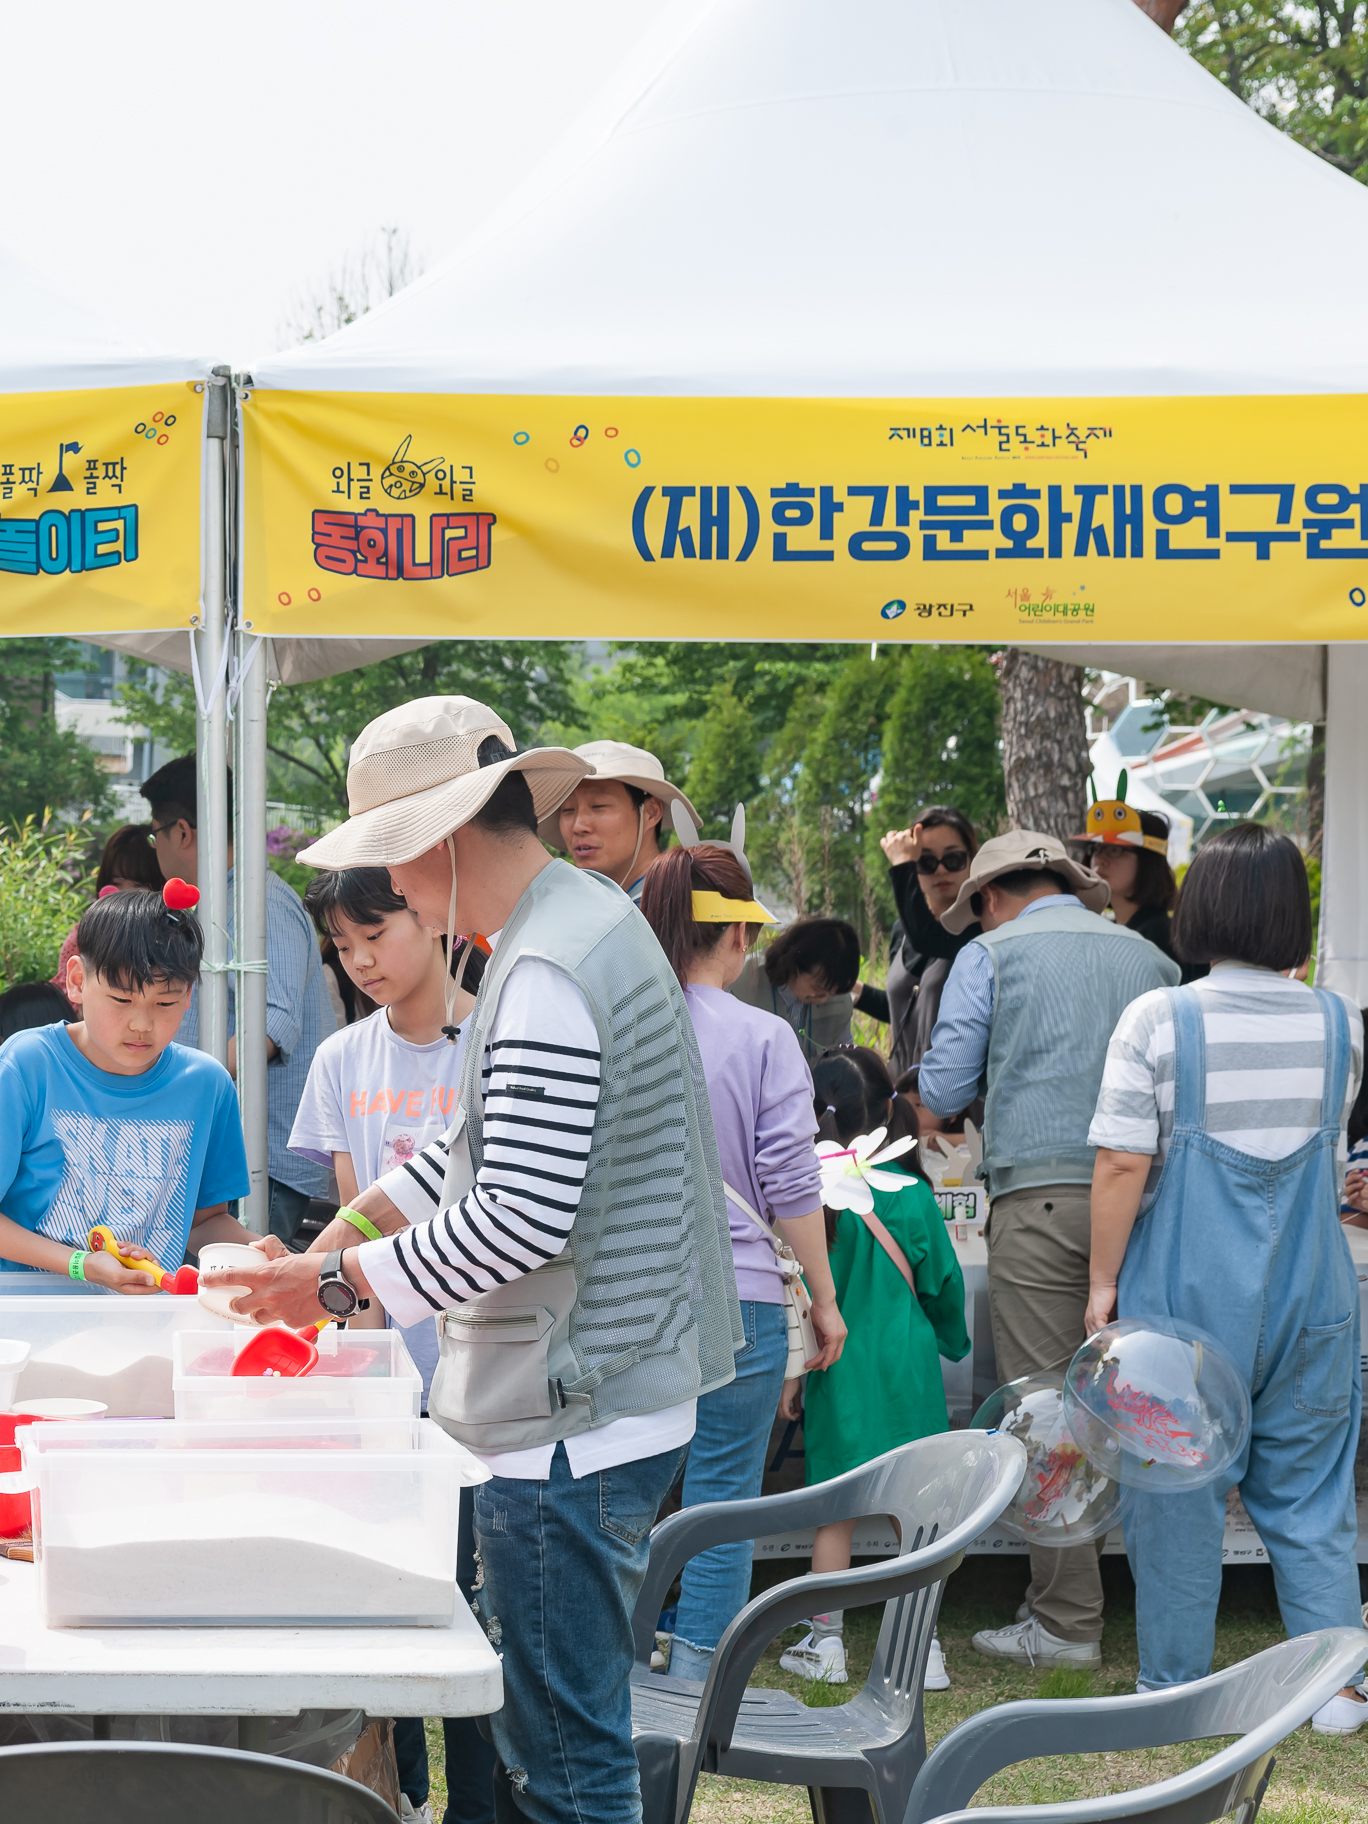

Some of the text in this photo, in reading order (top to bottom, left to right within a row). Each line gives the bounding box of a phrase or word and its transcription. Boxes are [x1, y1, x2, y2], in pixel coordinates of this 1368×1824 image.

[889, 418, 1113, 459] 제8회 서울동화축제
[0, 457, 127, 499] 폴짝 폴짝
[332, 461, 476, 502] 와글 와글
[312, 508, 497, 580] 동화나라
[913, 603, 975, 618] 광진구
[1018, 602, 1095, 617] 어린이대공원
[350, 1087, 424, 1118] HAVE
